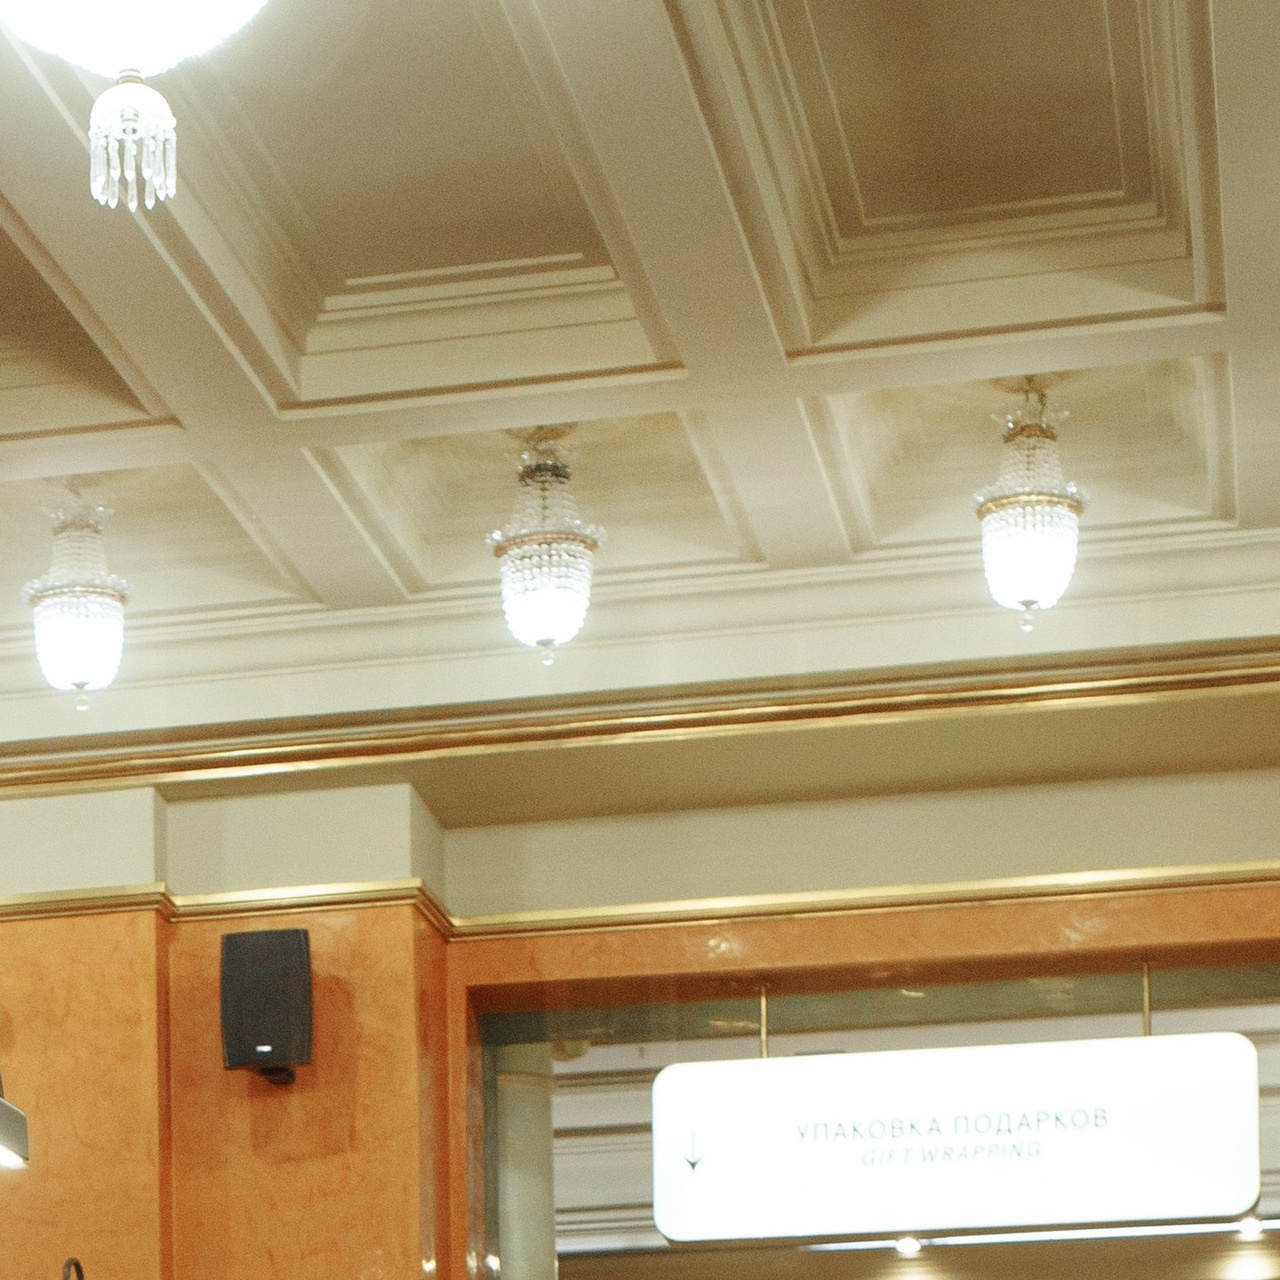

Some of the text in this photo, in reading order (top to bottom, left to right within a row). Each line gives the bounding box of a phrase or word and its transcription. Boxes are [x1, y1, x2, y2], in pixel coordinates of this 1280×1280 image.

[797, 1107, 1109, 1144] УПАКОВКА ПОДАРКОВ
[861, 1141, 1042, 1167] GIFT WRAPPING
